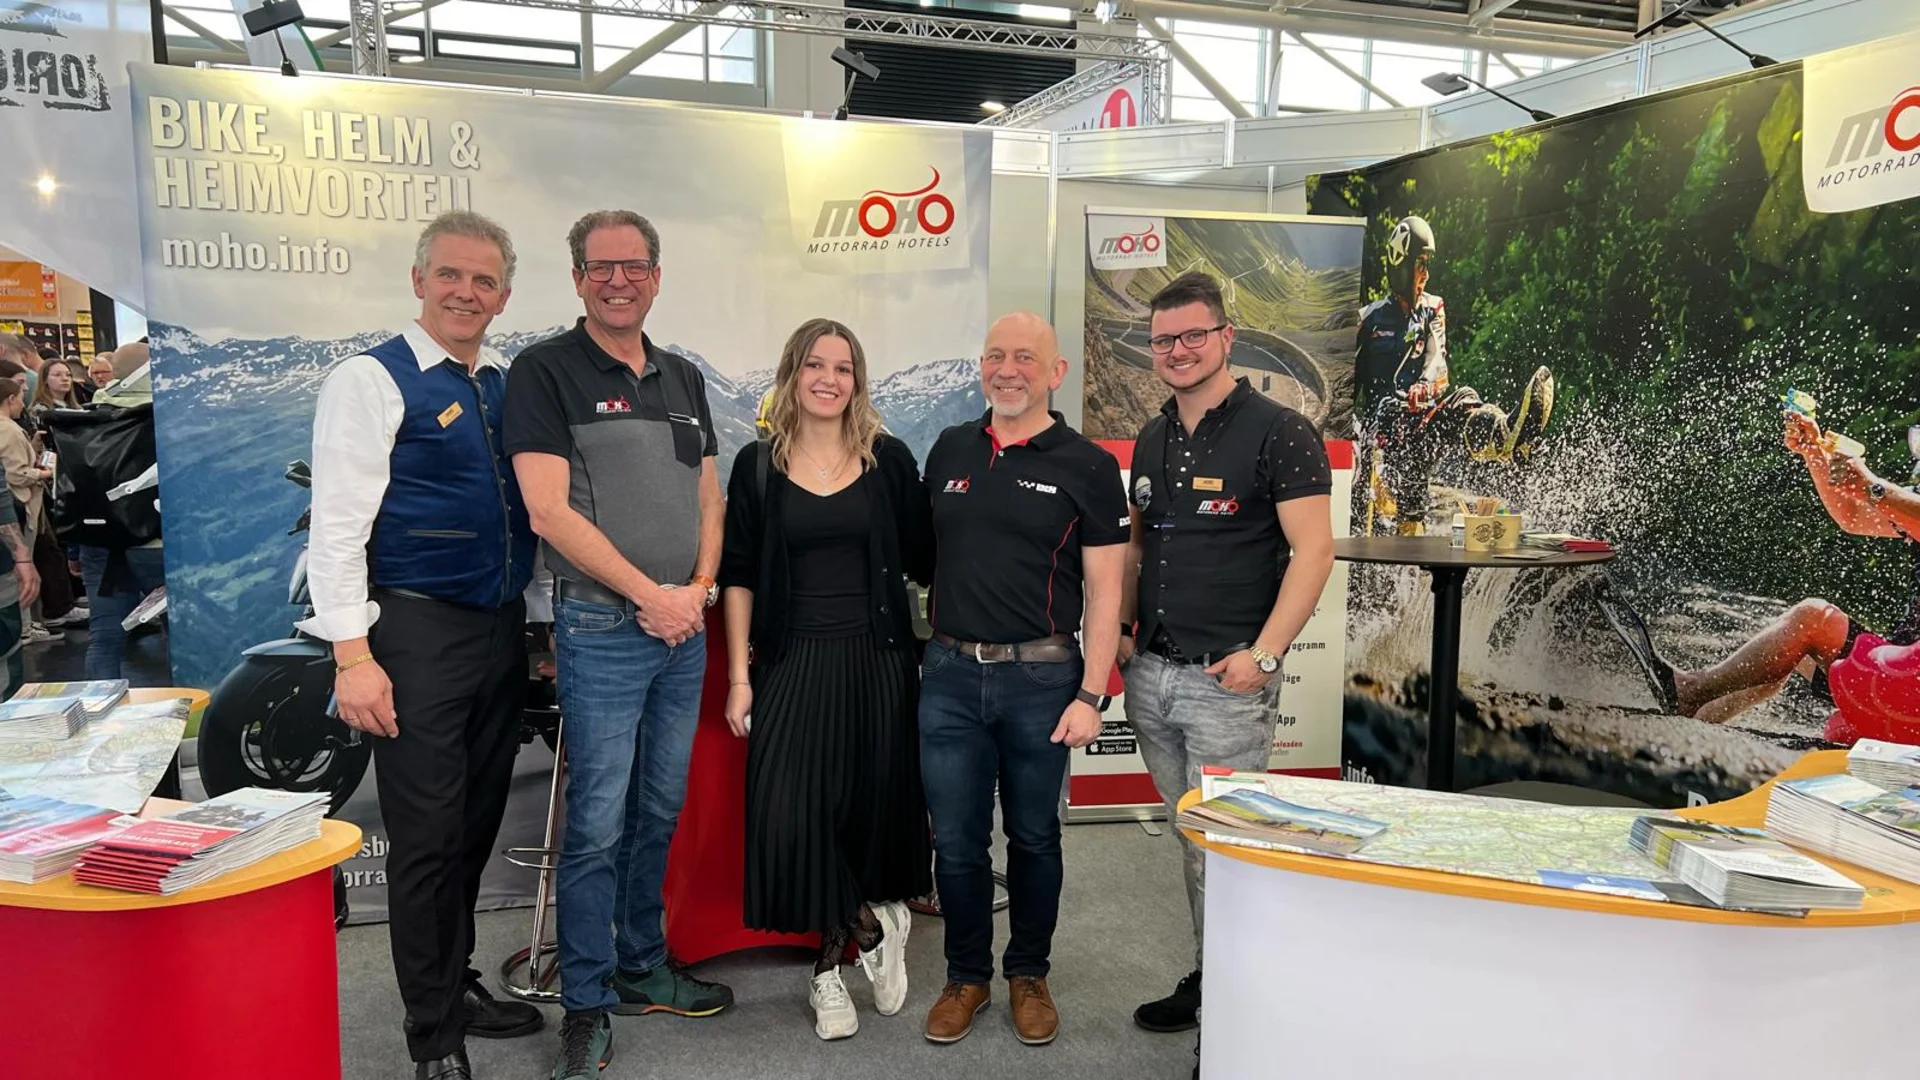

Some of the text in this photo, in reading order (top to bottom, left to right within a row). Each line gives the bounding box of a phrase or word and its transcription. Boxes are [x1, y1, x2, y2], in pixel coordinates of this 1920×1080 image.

[149, 96, 480, 169] BIKE, HELM &
[1817, 153, 1920, 190] MOTORRAD
[162, 232, 349, 274] moho.info
[807, 236, 951, 254] MOTORRAD HOTELS
[1292, 642, 1326, 652] ogramm
[1282, 674, 1301, 684] läge
[1277, 714, 1296, 726] App
[1122, 726, 1134, 734] Play
[1343, 760, 1374, 784] .info
